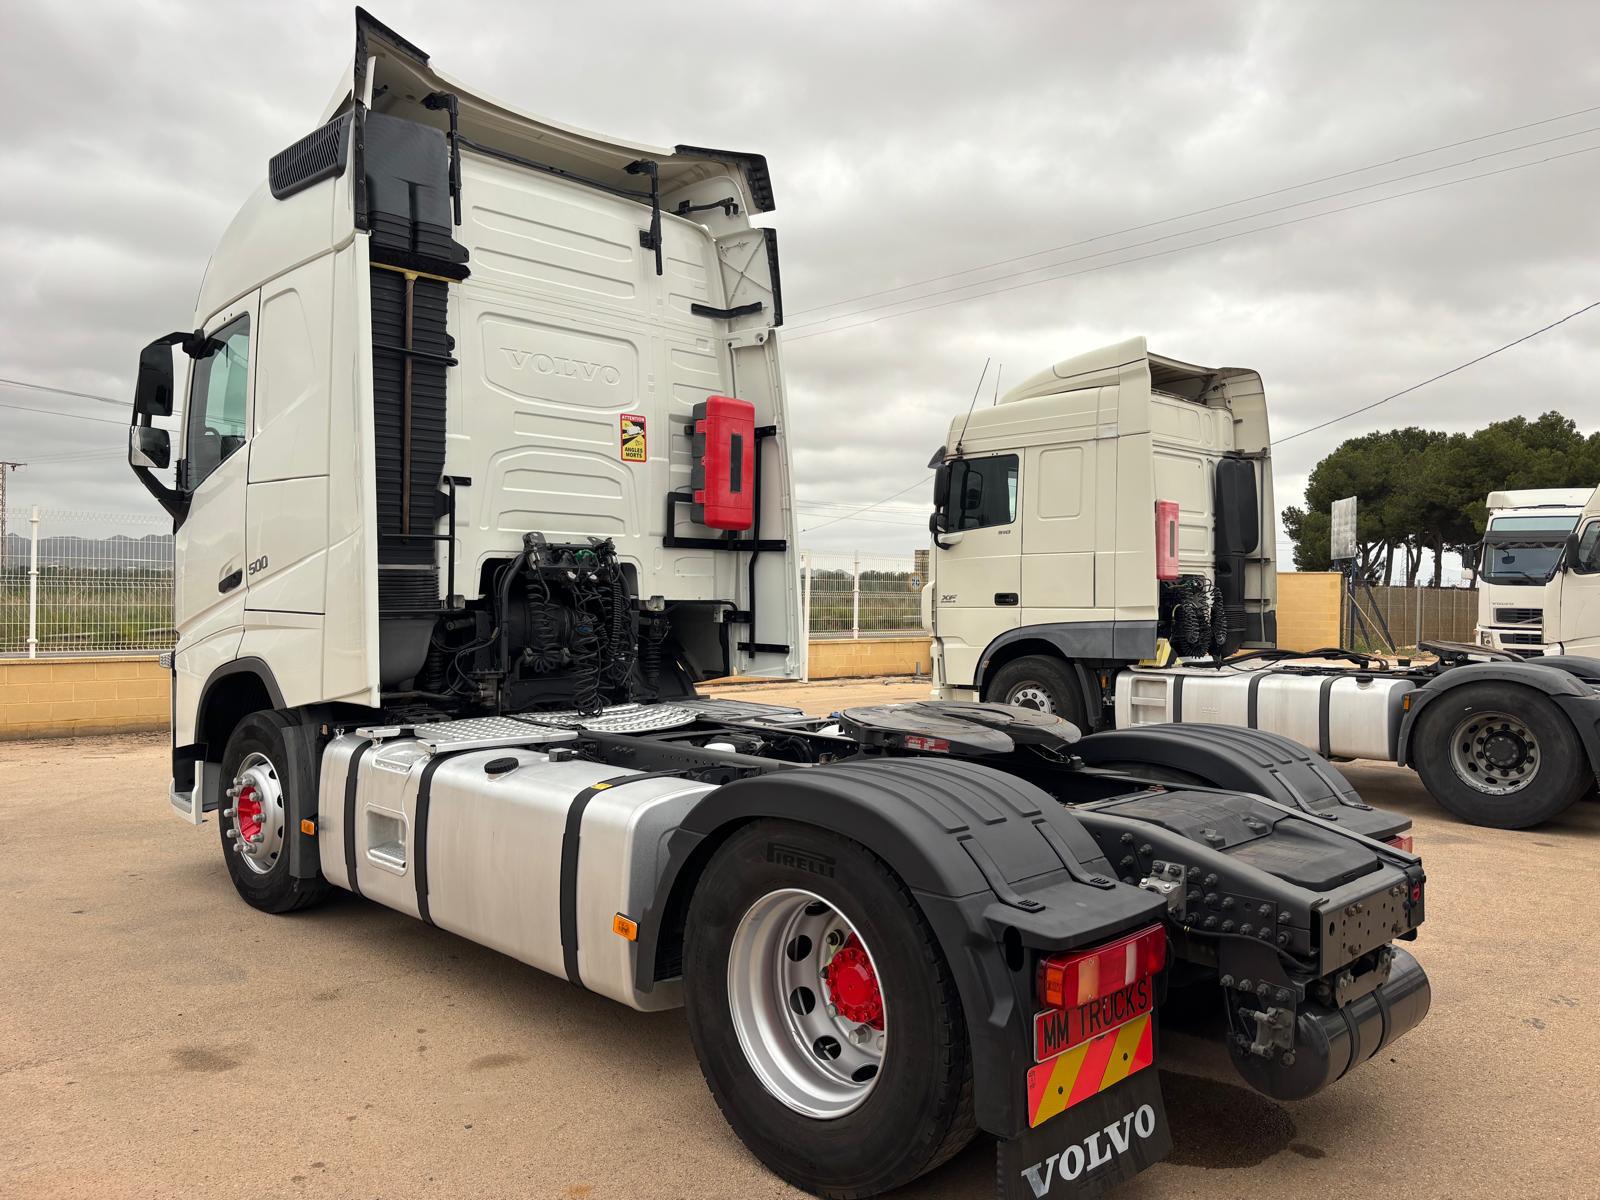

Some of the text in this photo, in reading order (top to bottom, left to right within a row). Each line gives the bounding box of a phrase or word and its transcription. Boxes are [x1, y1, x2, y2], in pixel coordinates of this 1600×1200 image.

[499, 347, 620, 385] VOLVO
[249, 555, 268, 575] 500
[766, 842, 836, 878] PIRELLI
[1043, 980, 1147, 1053] MM TRUCKS
[1021, 1104, 1155, 1199] VOLVO
